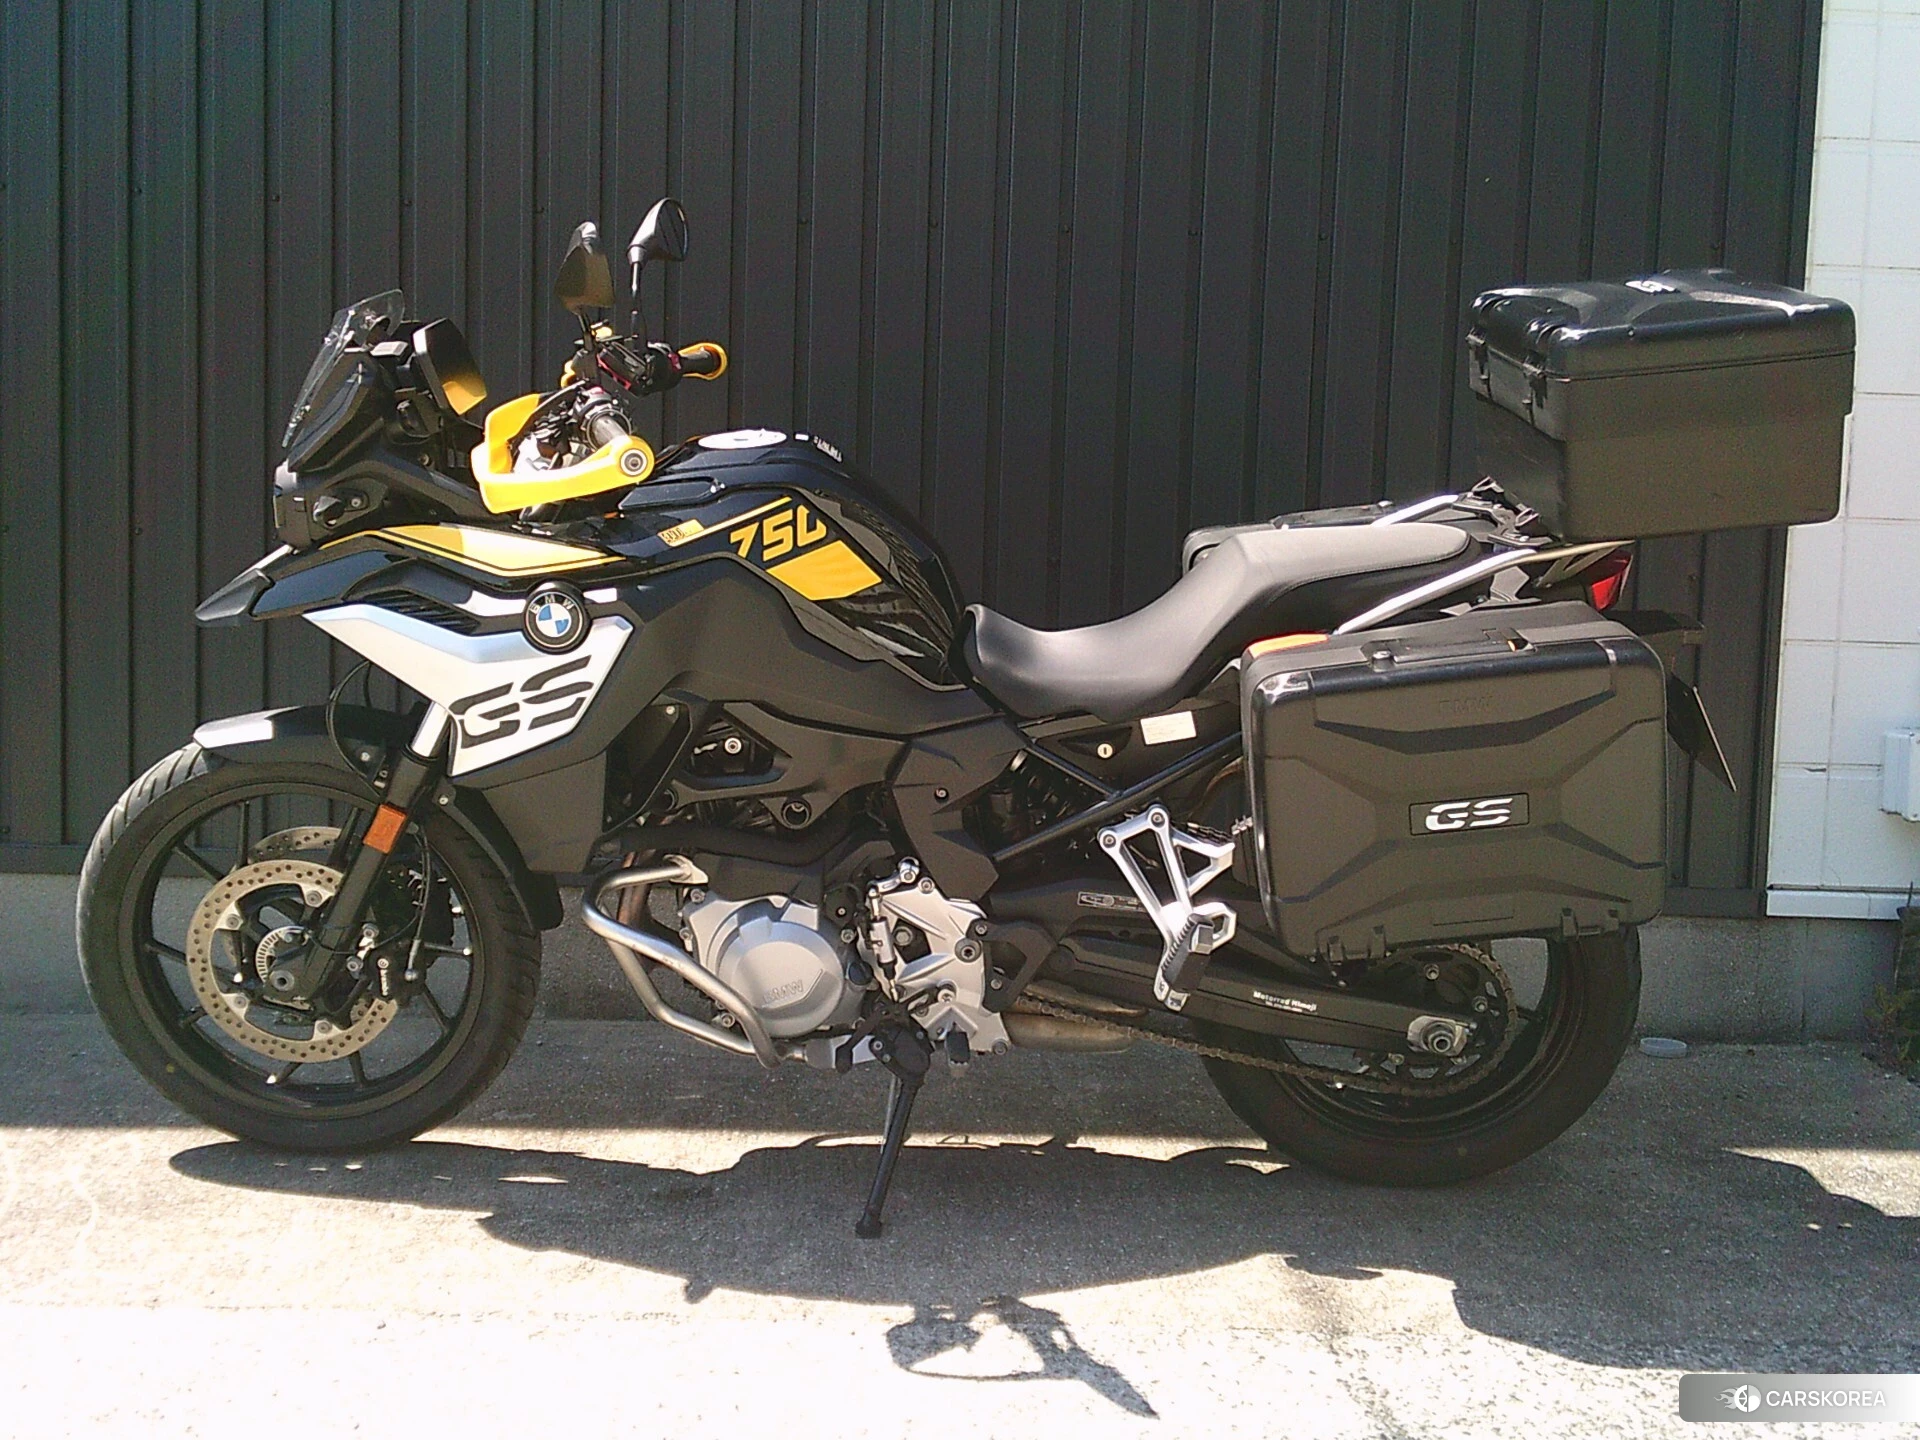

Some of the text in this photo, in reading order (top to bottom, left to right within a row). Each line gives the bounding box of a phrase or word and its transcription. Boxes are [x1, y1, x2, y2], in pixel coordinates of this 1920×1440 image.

[729, 503, 827, 562] 750
[528, 594, 575, 615] BMW
[448, 654, 594, 749] GS
[1425, 797, 1513, 832] GS
[763, 979, 804, 1004] BMW
